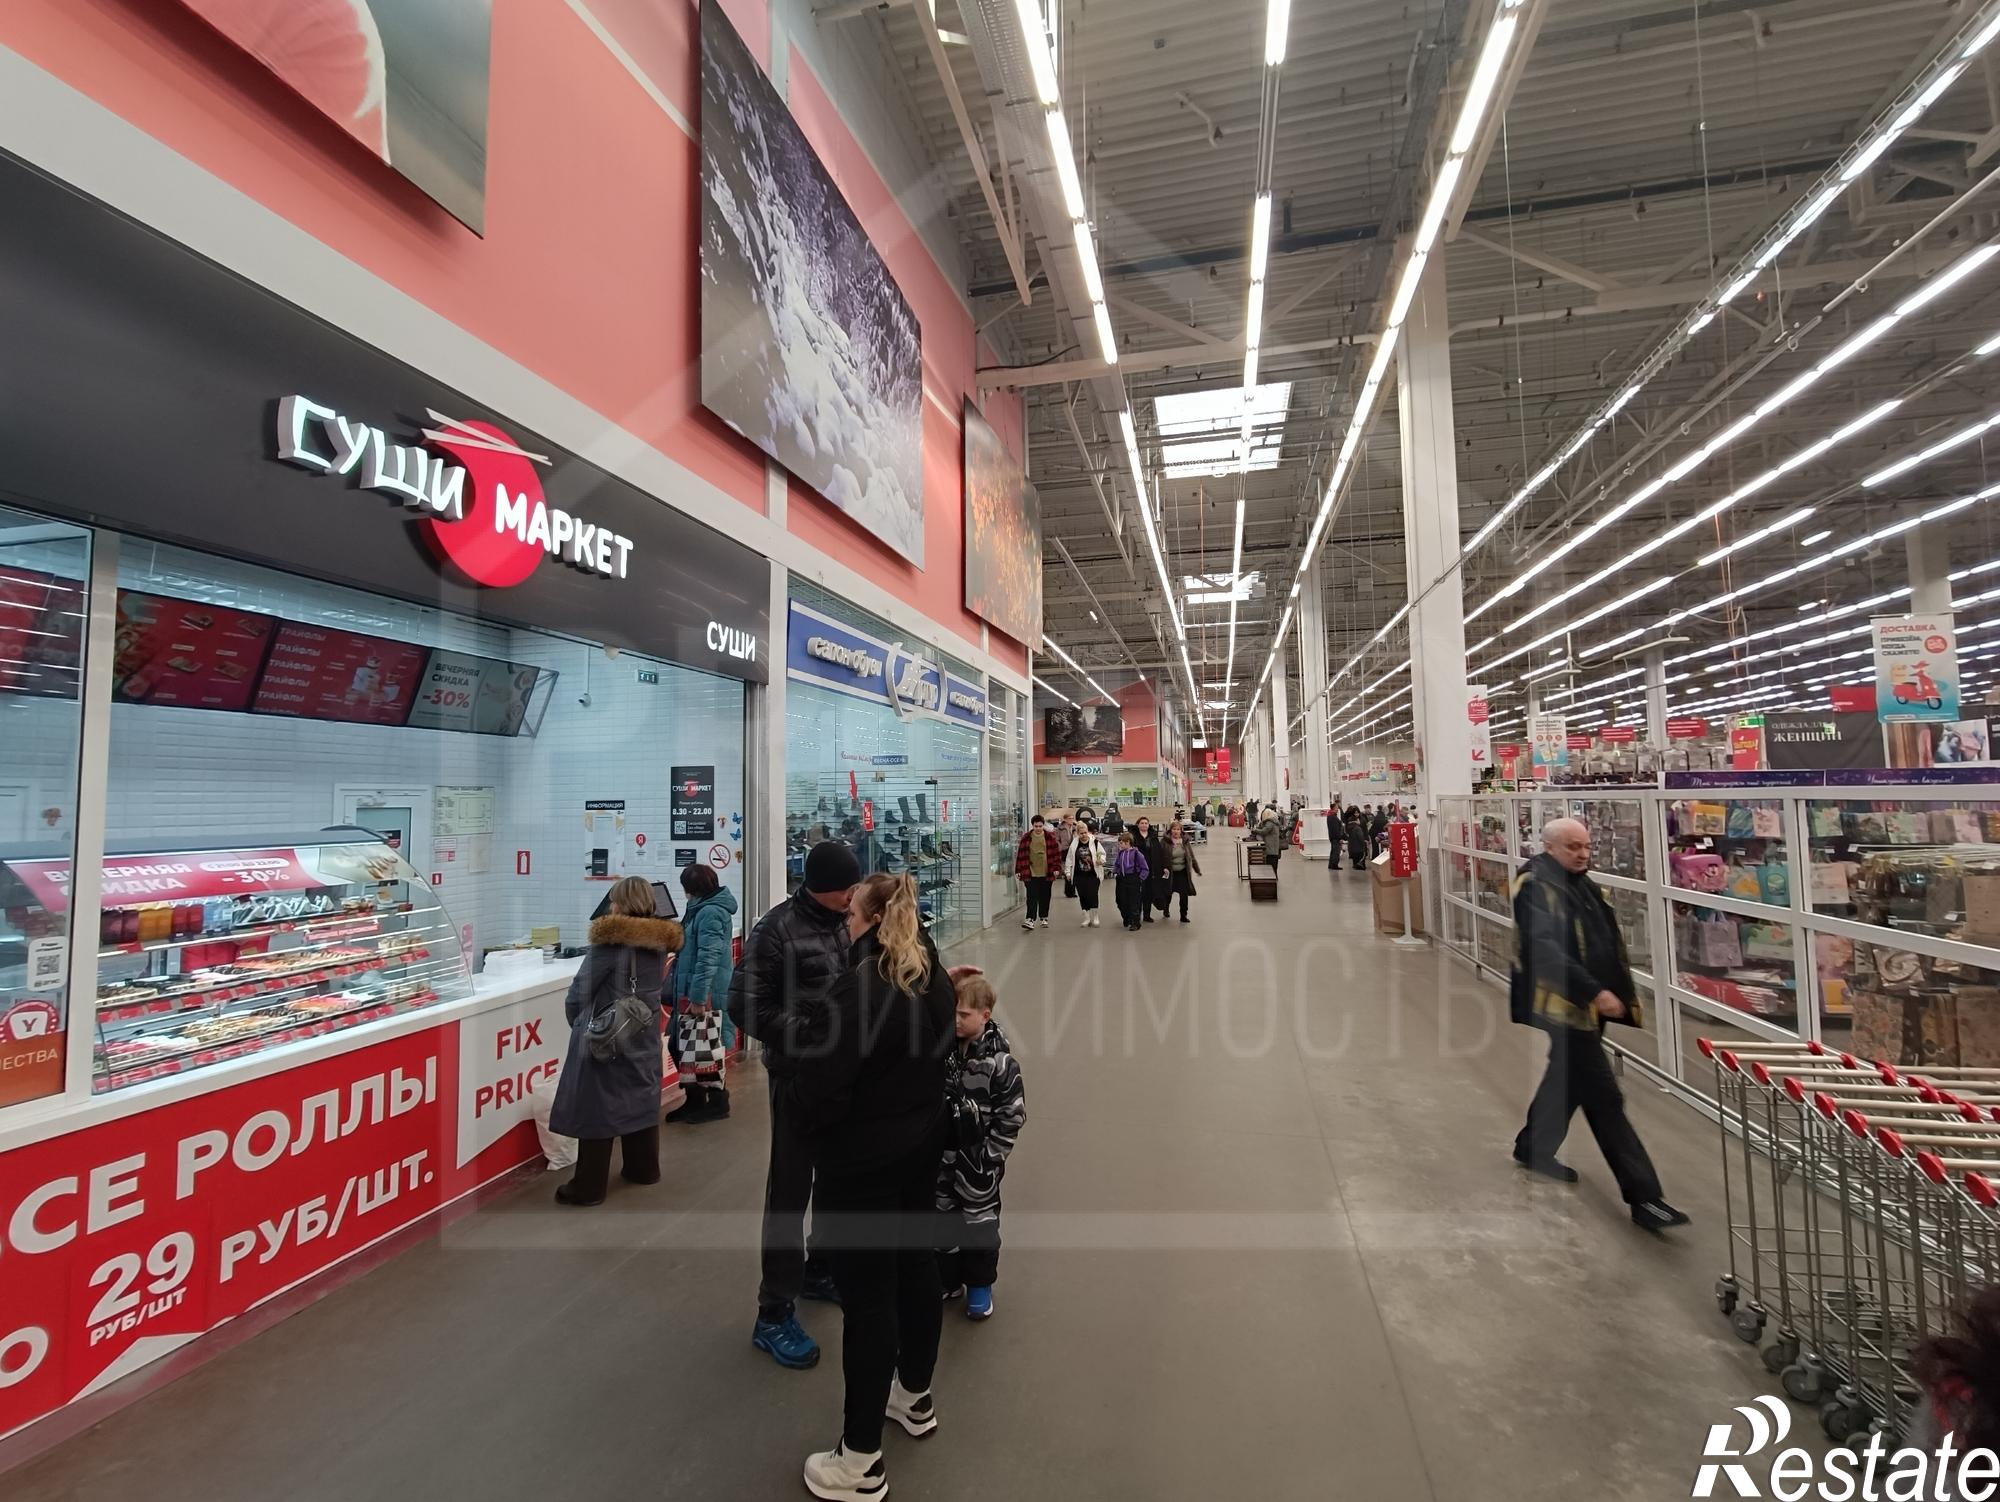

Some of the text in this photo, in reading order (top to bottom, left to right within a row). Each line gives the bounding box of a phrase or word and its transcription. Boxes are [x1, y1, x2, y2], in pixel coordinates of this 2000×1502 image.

[495, 483, 634, 579] МАРКЕТ
[1880, 624, 1936, 634] ДОСТАВКА
[706, 621, 757, 662] СУШИ
[431, 673, 469, 687] СКИДКА
[435, 662, 480, 678] ВЕЧЕРНЯЯ
[422, 688, 471, 709] -30%
[587, 802, 624, 810] ИНФОРМАЦИЯ
[1400, 827, 1411, 872] РАЗМЕН
[44, 863, 193, 882] ВЕРНЯЯ
[60, 877, 188, 896] ИДКА
[496, 1018, 543, 1060] FIX
[0, 1048, 58, 1071] ЕСТВА
[0, 1056, 438, 1262] СЕ РОЛЛЫ
[87, 1231, 195, 1329] 29
[220, 1149, 434, 1284] РУБ/ШТ.
[89, 1287, 188, 1348] РУБ/ШТ
